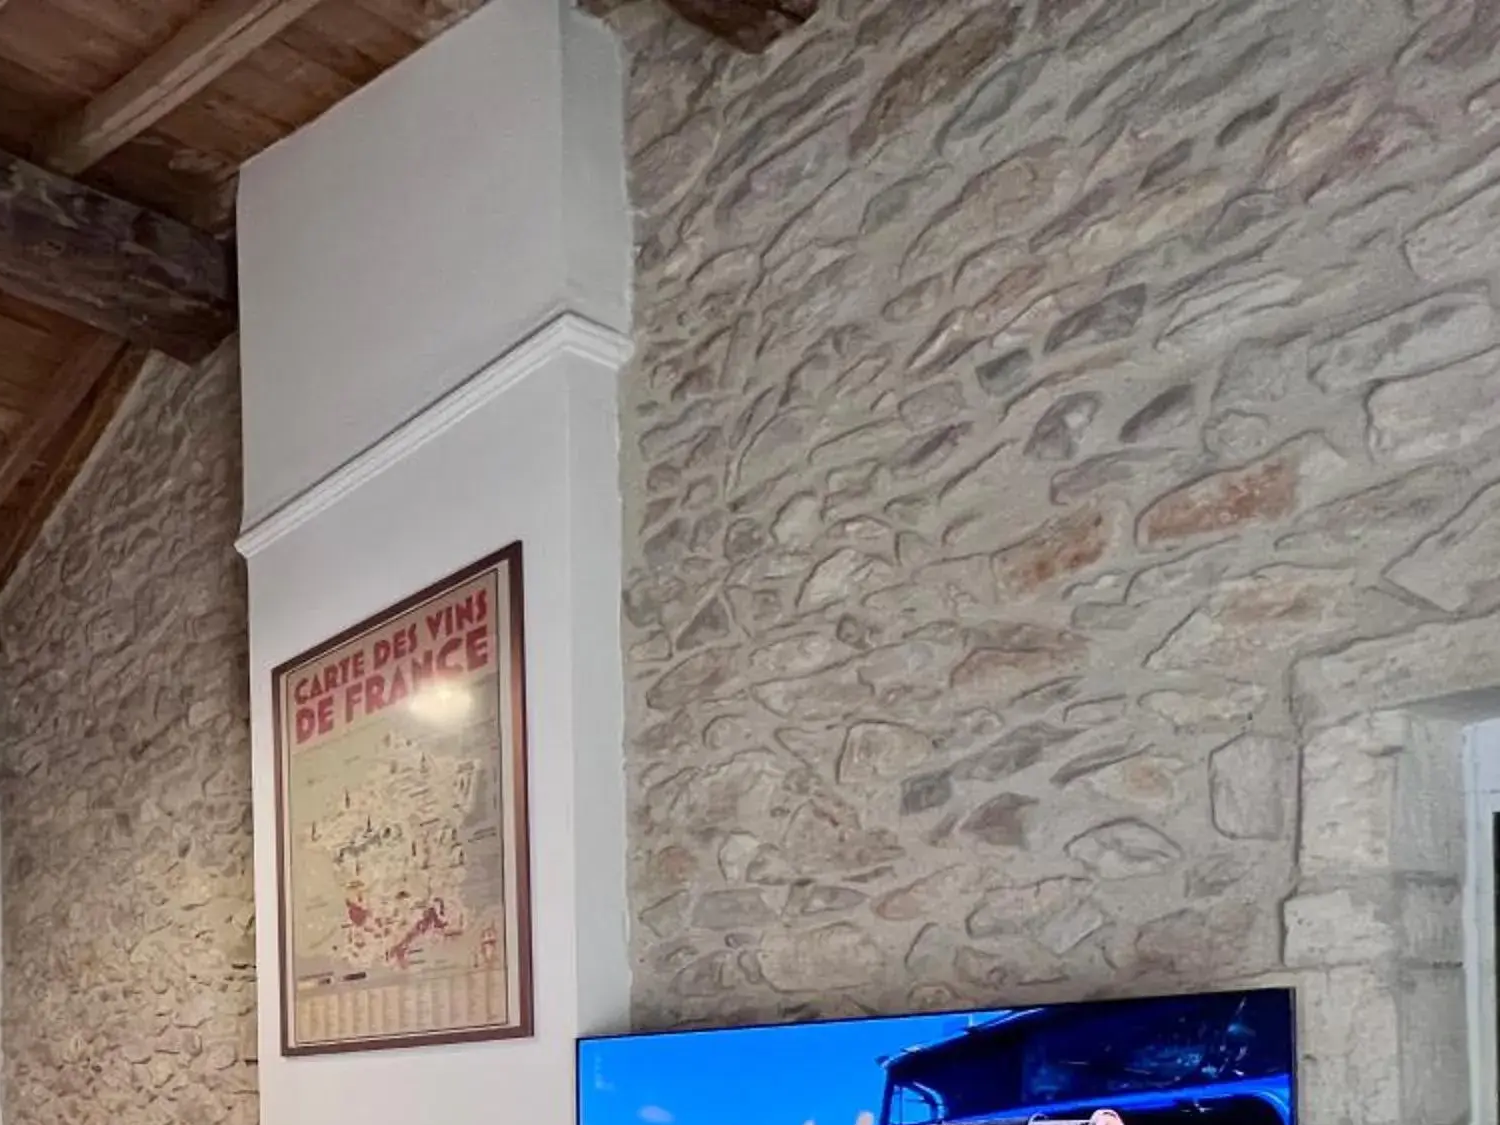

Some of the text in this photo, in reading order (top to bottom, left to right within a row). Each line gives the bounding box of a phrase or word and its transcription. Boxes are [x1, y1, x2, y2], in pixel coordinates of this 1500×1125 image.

[294, 589, 488, 705] CARTE DES VINS
[295, 625, 489, 744] DE FRANCE
